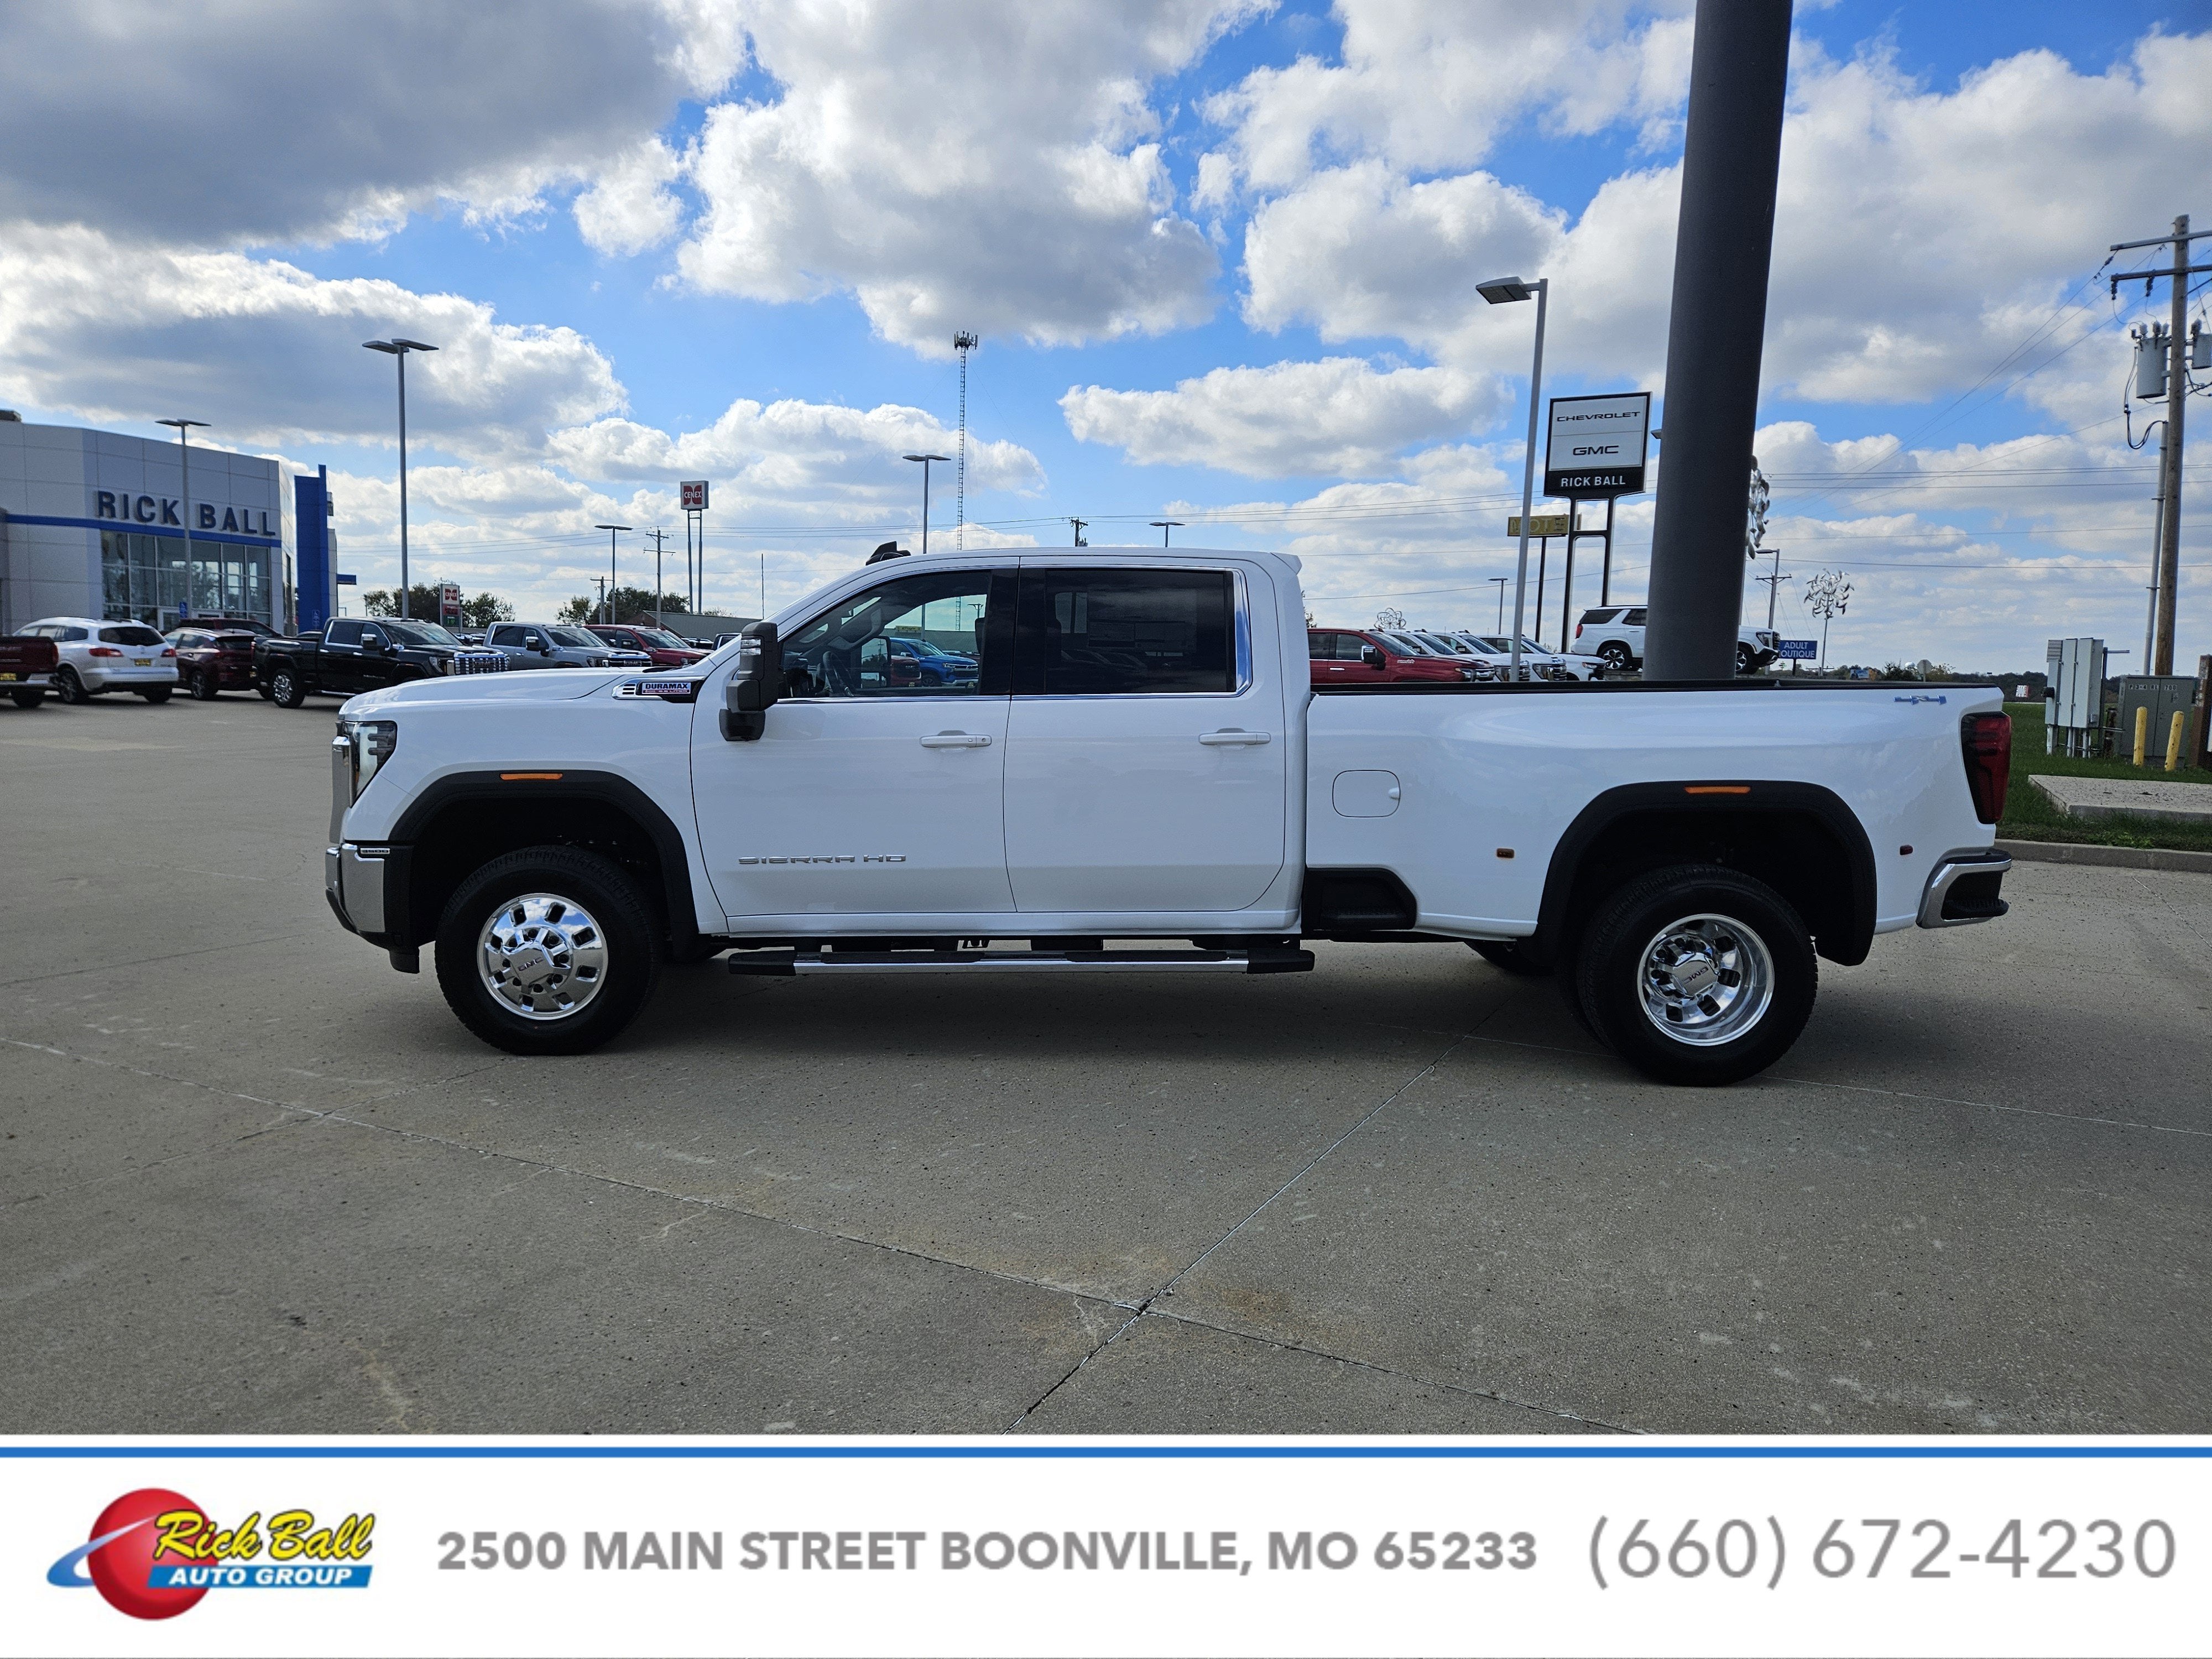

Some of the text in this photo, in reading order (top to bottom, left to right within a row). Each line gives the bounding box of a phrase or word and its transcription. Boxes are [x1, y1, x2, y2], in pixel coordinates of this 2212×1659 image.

[1557, 411, 1641, 422] CHEVROLET
[1573, 445, 1619, 456] GMC
[1561, 476, 1626, 487] RICK BALL
[97, 491, 276, 536] RICK BALL
[1778, 650, 1815, 658] OUTIQUE
[739, 855, 855, 864] SIERRA
[518, 957, 544, 972] GMC
[1682, 966, 1709, 984] GMC
